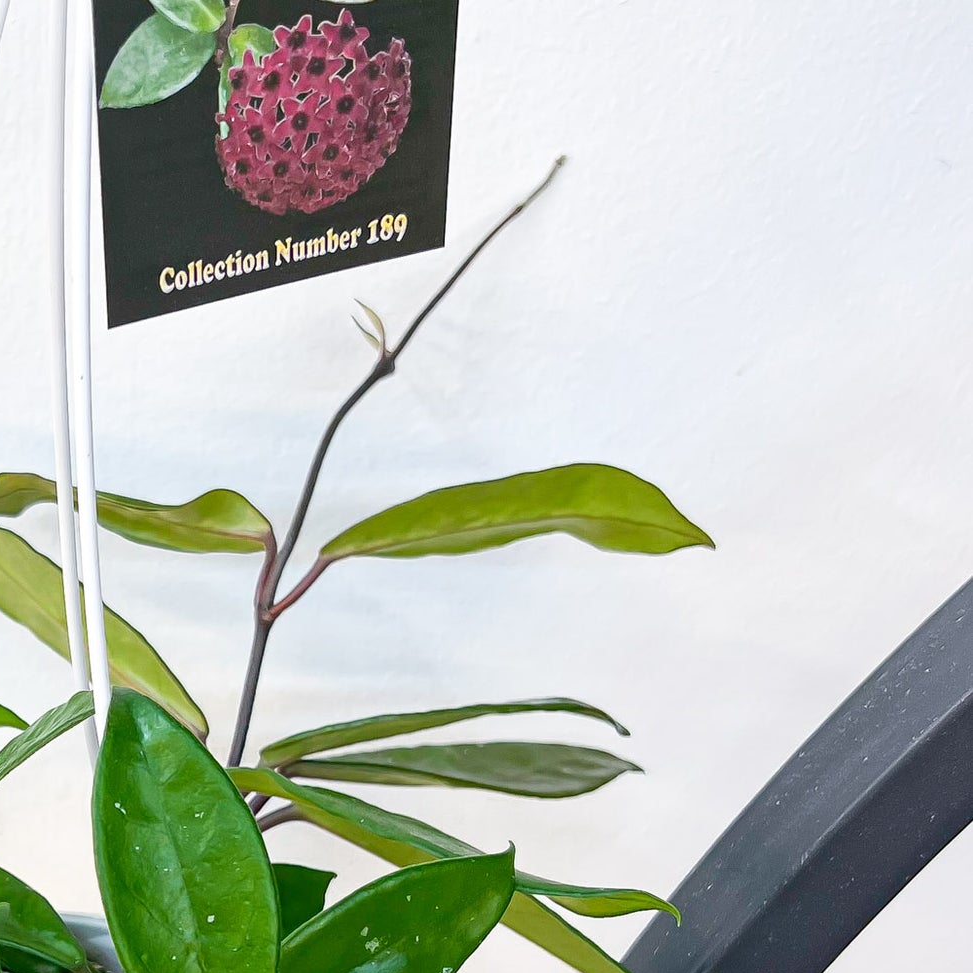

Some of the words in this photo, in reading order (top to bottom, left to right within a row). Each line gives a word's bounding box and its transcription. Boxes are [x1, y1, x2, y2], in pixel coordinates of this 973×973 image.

[158, 249, 270, 294] Collection
[274, 227, 362, 267] Number
[366, 213, 408, 245] 189
